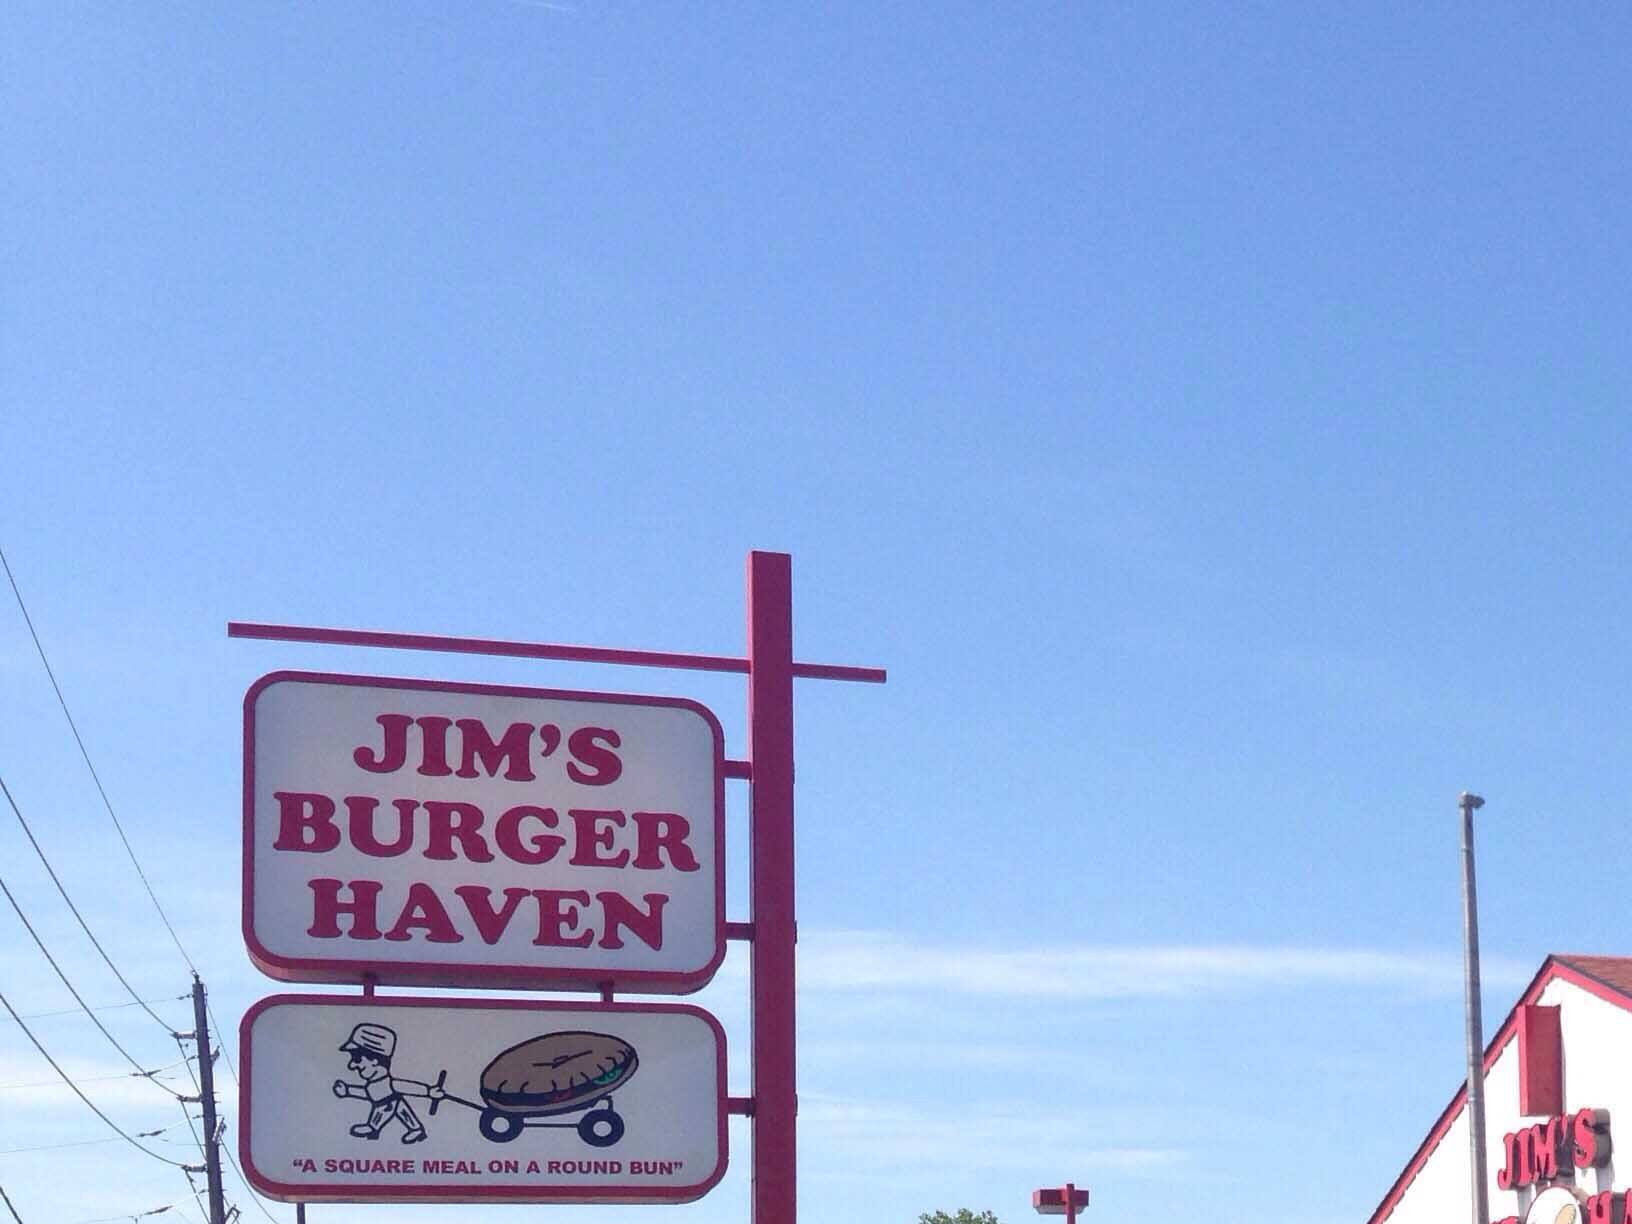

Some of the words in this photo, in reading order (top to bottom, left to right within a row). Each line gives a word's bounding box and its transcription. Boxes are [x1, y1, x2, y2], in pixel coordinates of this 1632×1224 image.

[353, 714, 624, 787] JIM'S
[273, 791, 700, 873] BURGER
[307, 879, 669, 951] HAVEN
[324, 1159, 415, 1175] SQUARE
[422, 1160, 482, 1175] MEAL
[488, 1160, 519, 1174] ON
[526, 1160, 541, 1175] A
[547, 1160, 622, 1175] ROUND
[1498, 1108, 1599, 1190] JIM'S
